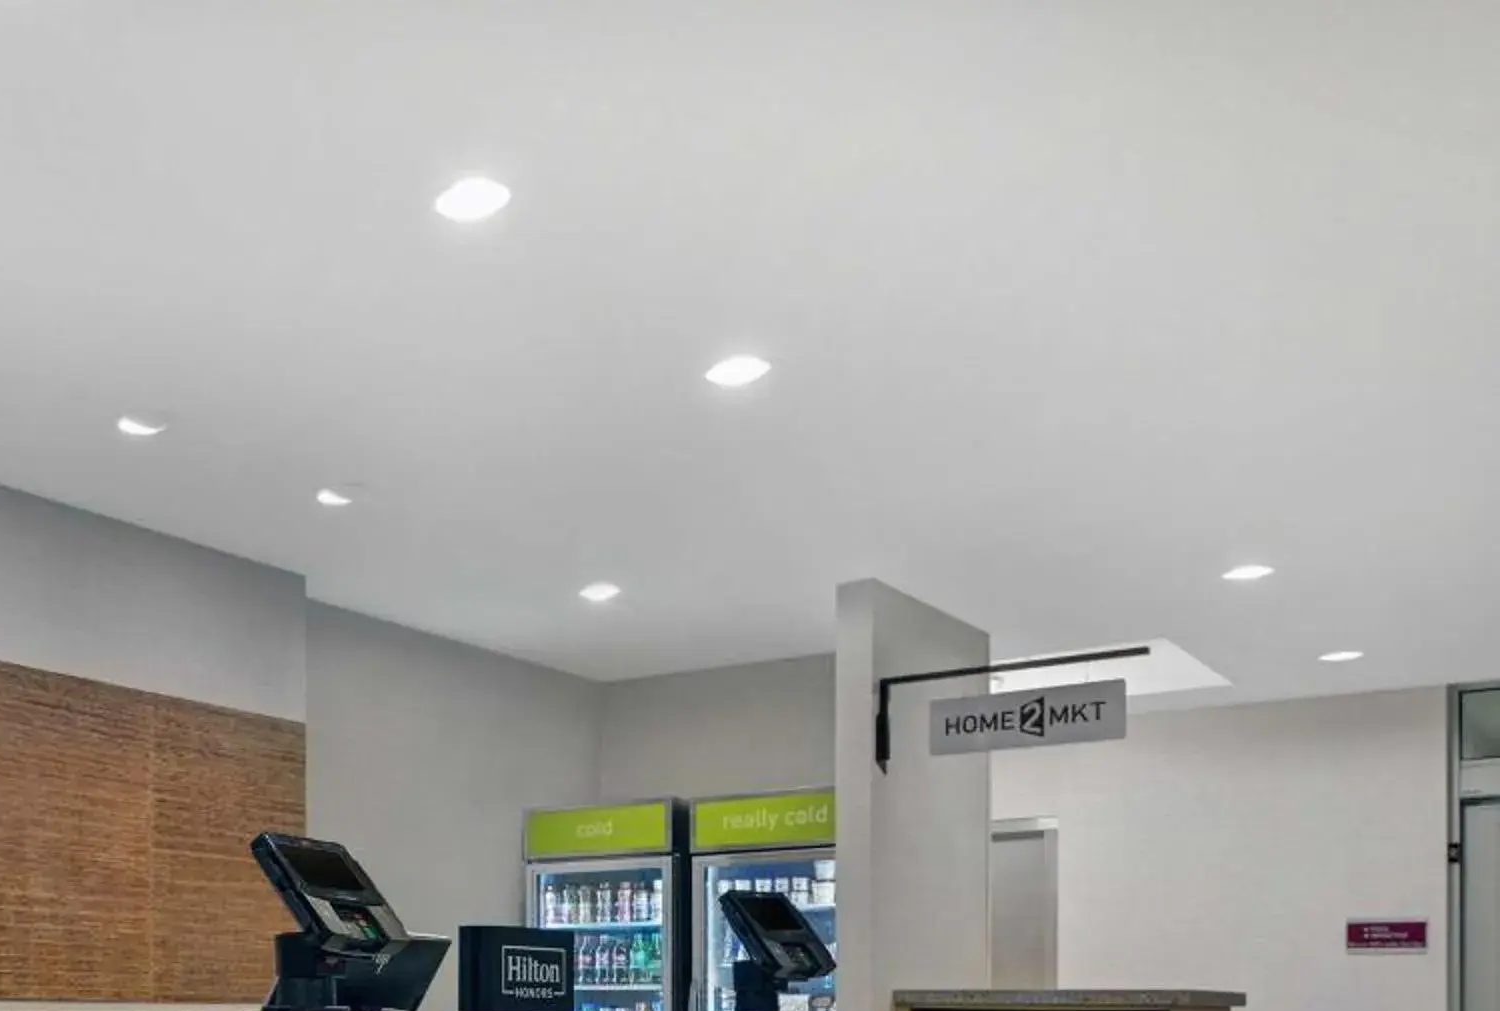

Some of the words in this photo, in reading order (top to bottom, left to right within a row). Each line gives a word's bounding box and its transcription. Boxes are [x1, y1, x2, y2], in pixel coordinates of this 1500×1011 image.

[576, 819, 614, 838] cold
[722, 809, 779, 831] really
[784, 804, 829, 826] cold
[507, 955, 560, 983] Hilton
